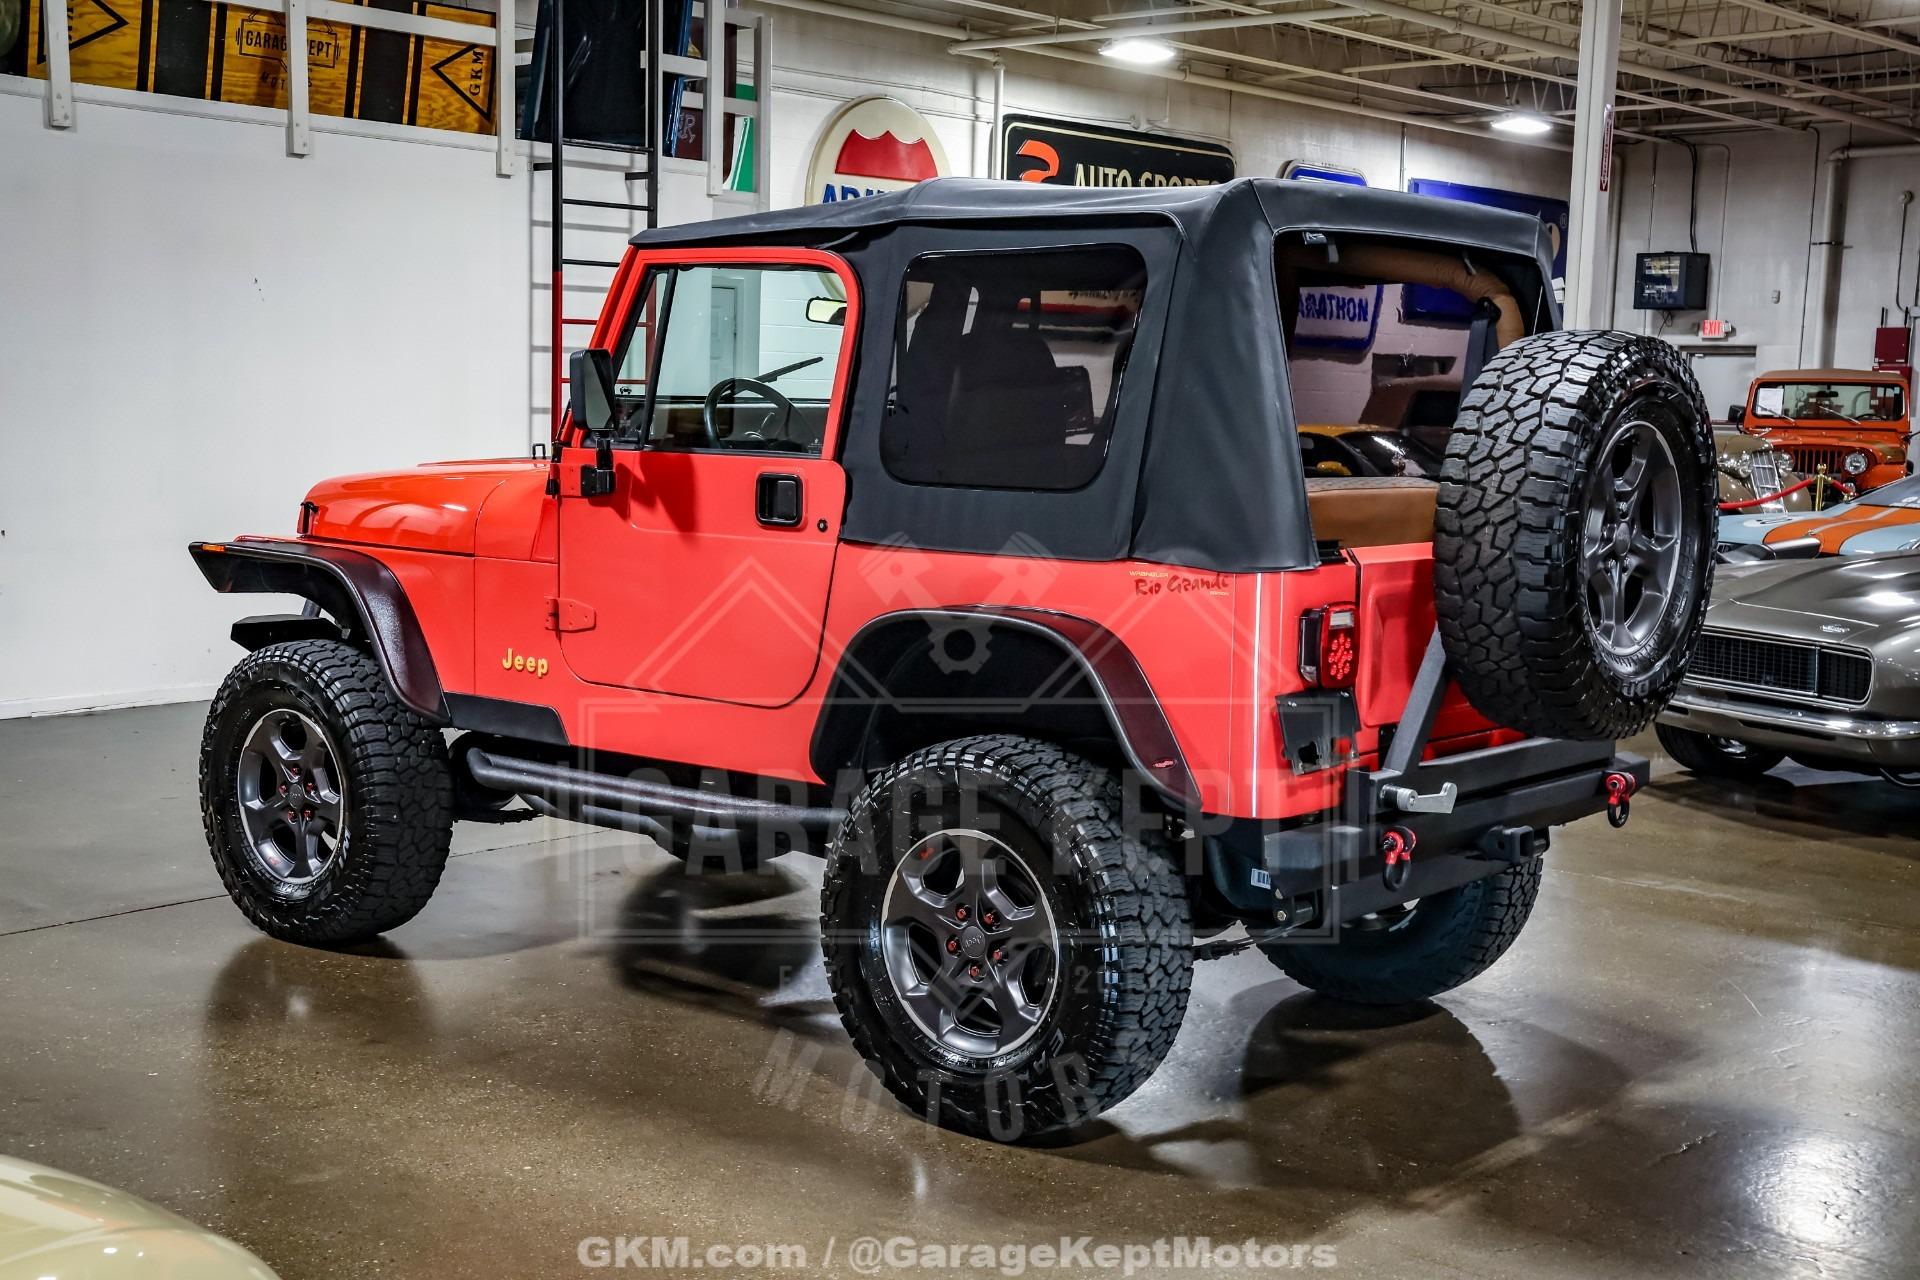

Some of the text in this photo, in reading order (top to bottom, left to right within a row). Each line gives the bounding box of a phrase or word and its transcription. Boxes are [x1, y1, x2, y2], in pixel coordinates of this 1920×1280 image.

[245, 30, 332, 58] GARAG EPT
[260, 70, 313, 91] MOTS
[469, 49, 484, 96] GKM
[1134, 572, 1229, 596] Rio Grande
[502, 647, 549, 679] Jeep
